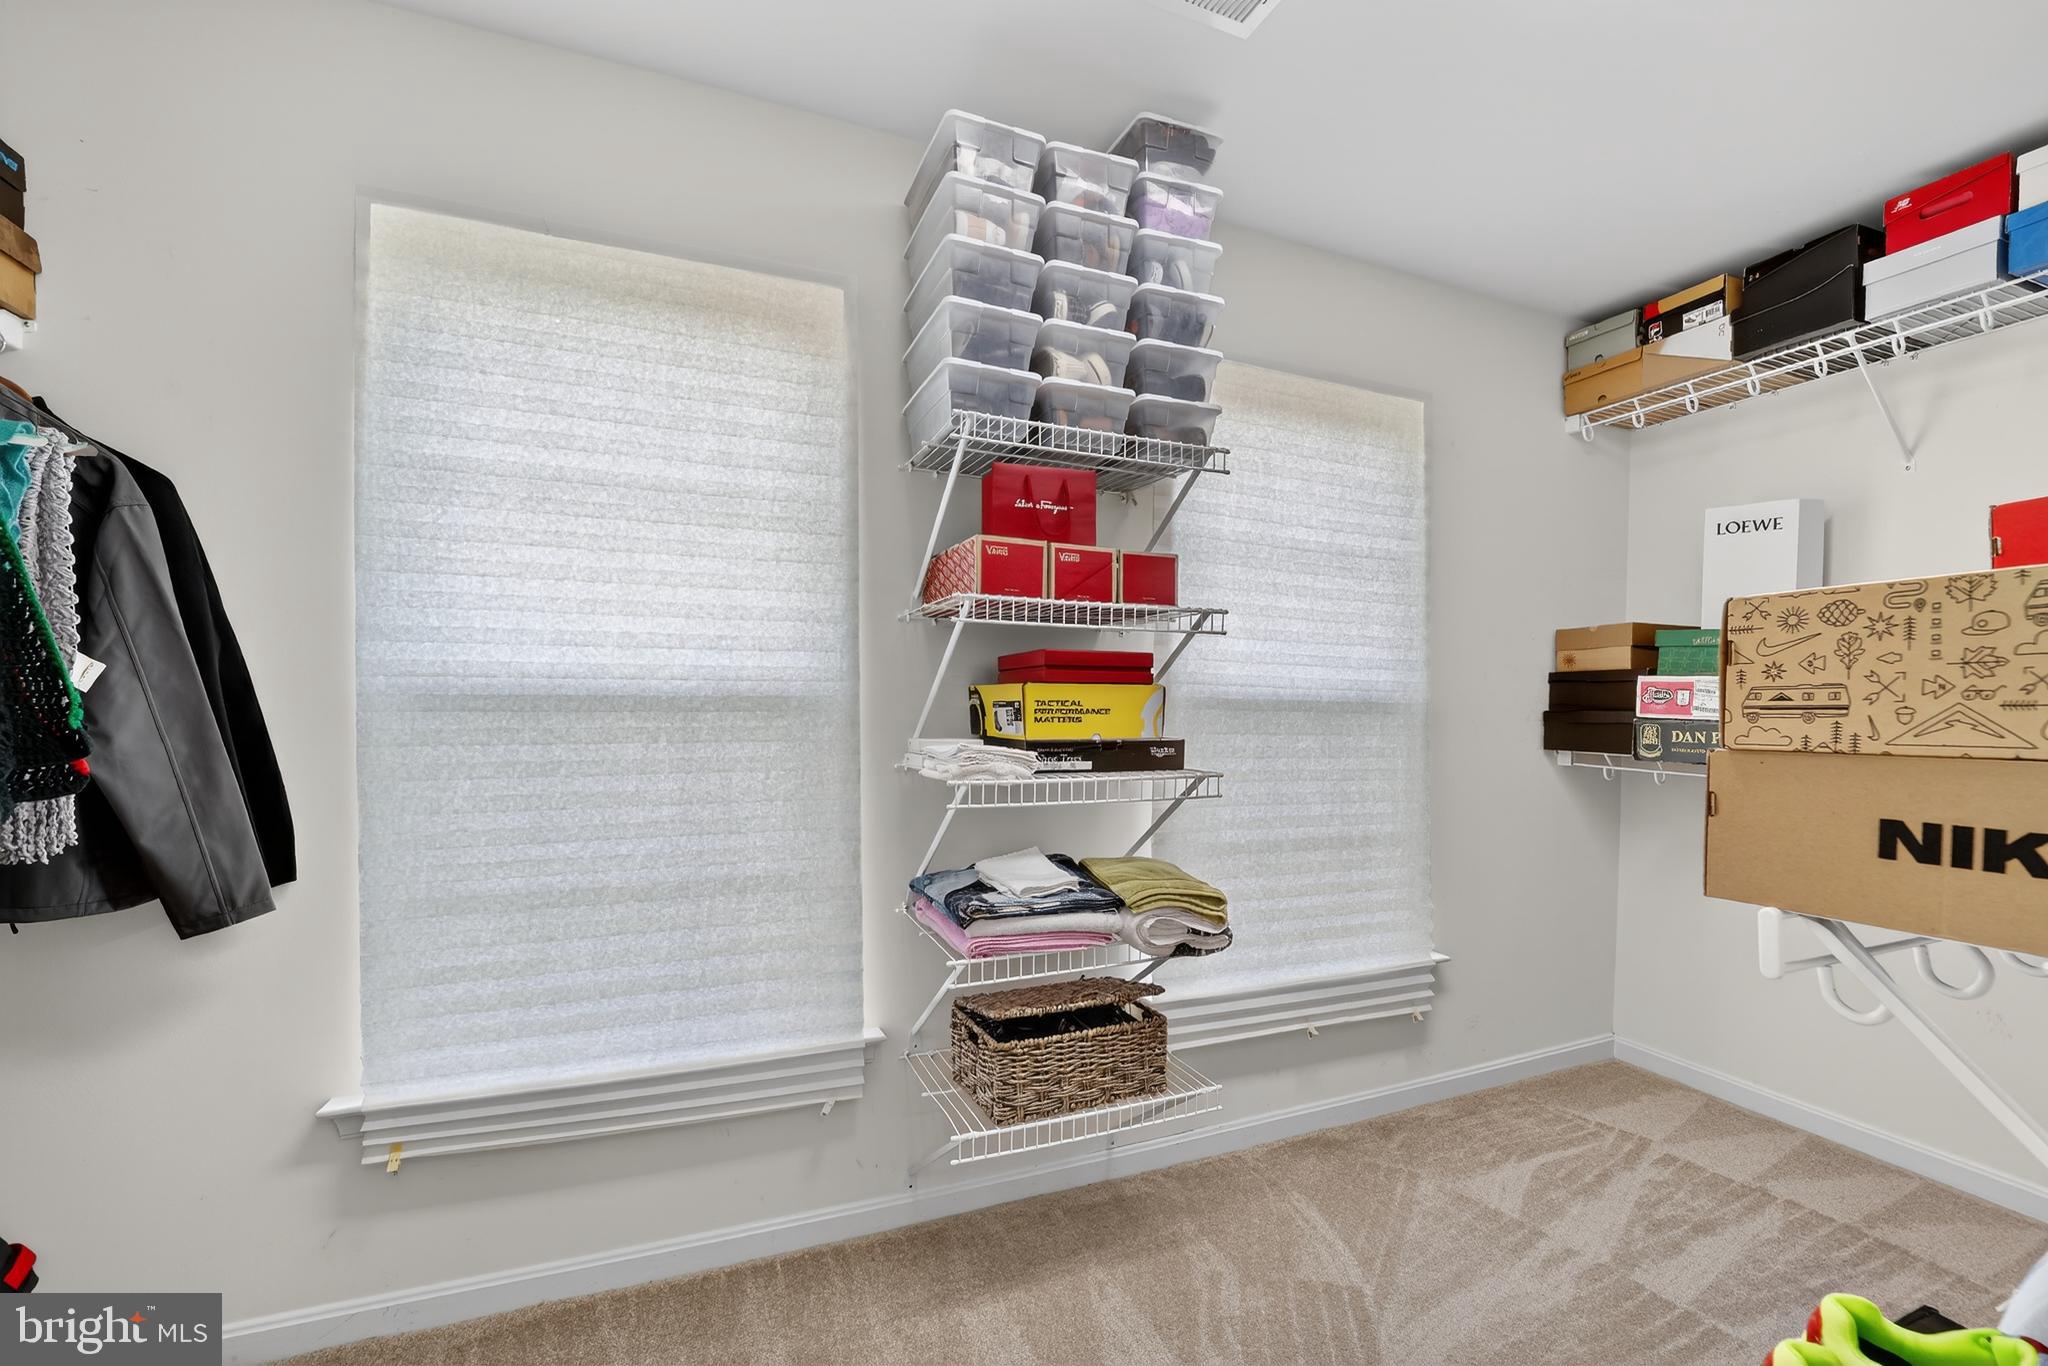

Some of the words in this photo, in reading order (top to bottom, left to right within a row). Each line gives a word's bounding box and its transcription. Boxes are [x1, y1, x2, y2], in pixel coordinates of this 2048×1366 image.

[1716, 517, 1783, 535] LOEWE
[1034, 699, 1083, 707] TACTICAL
[1671, 730, 1706, 743] DAN
[1878, 818, 2048, 879] NIK
